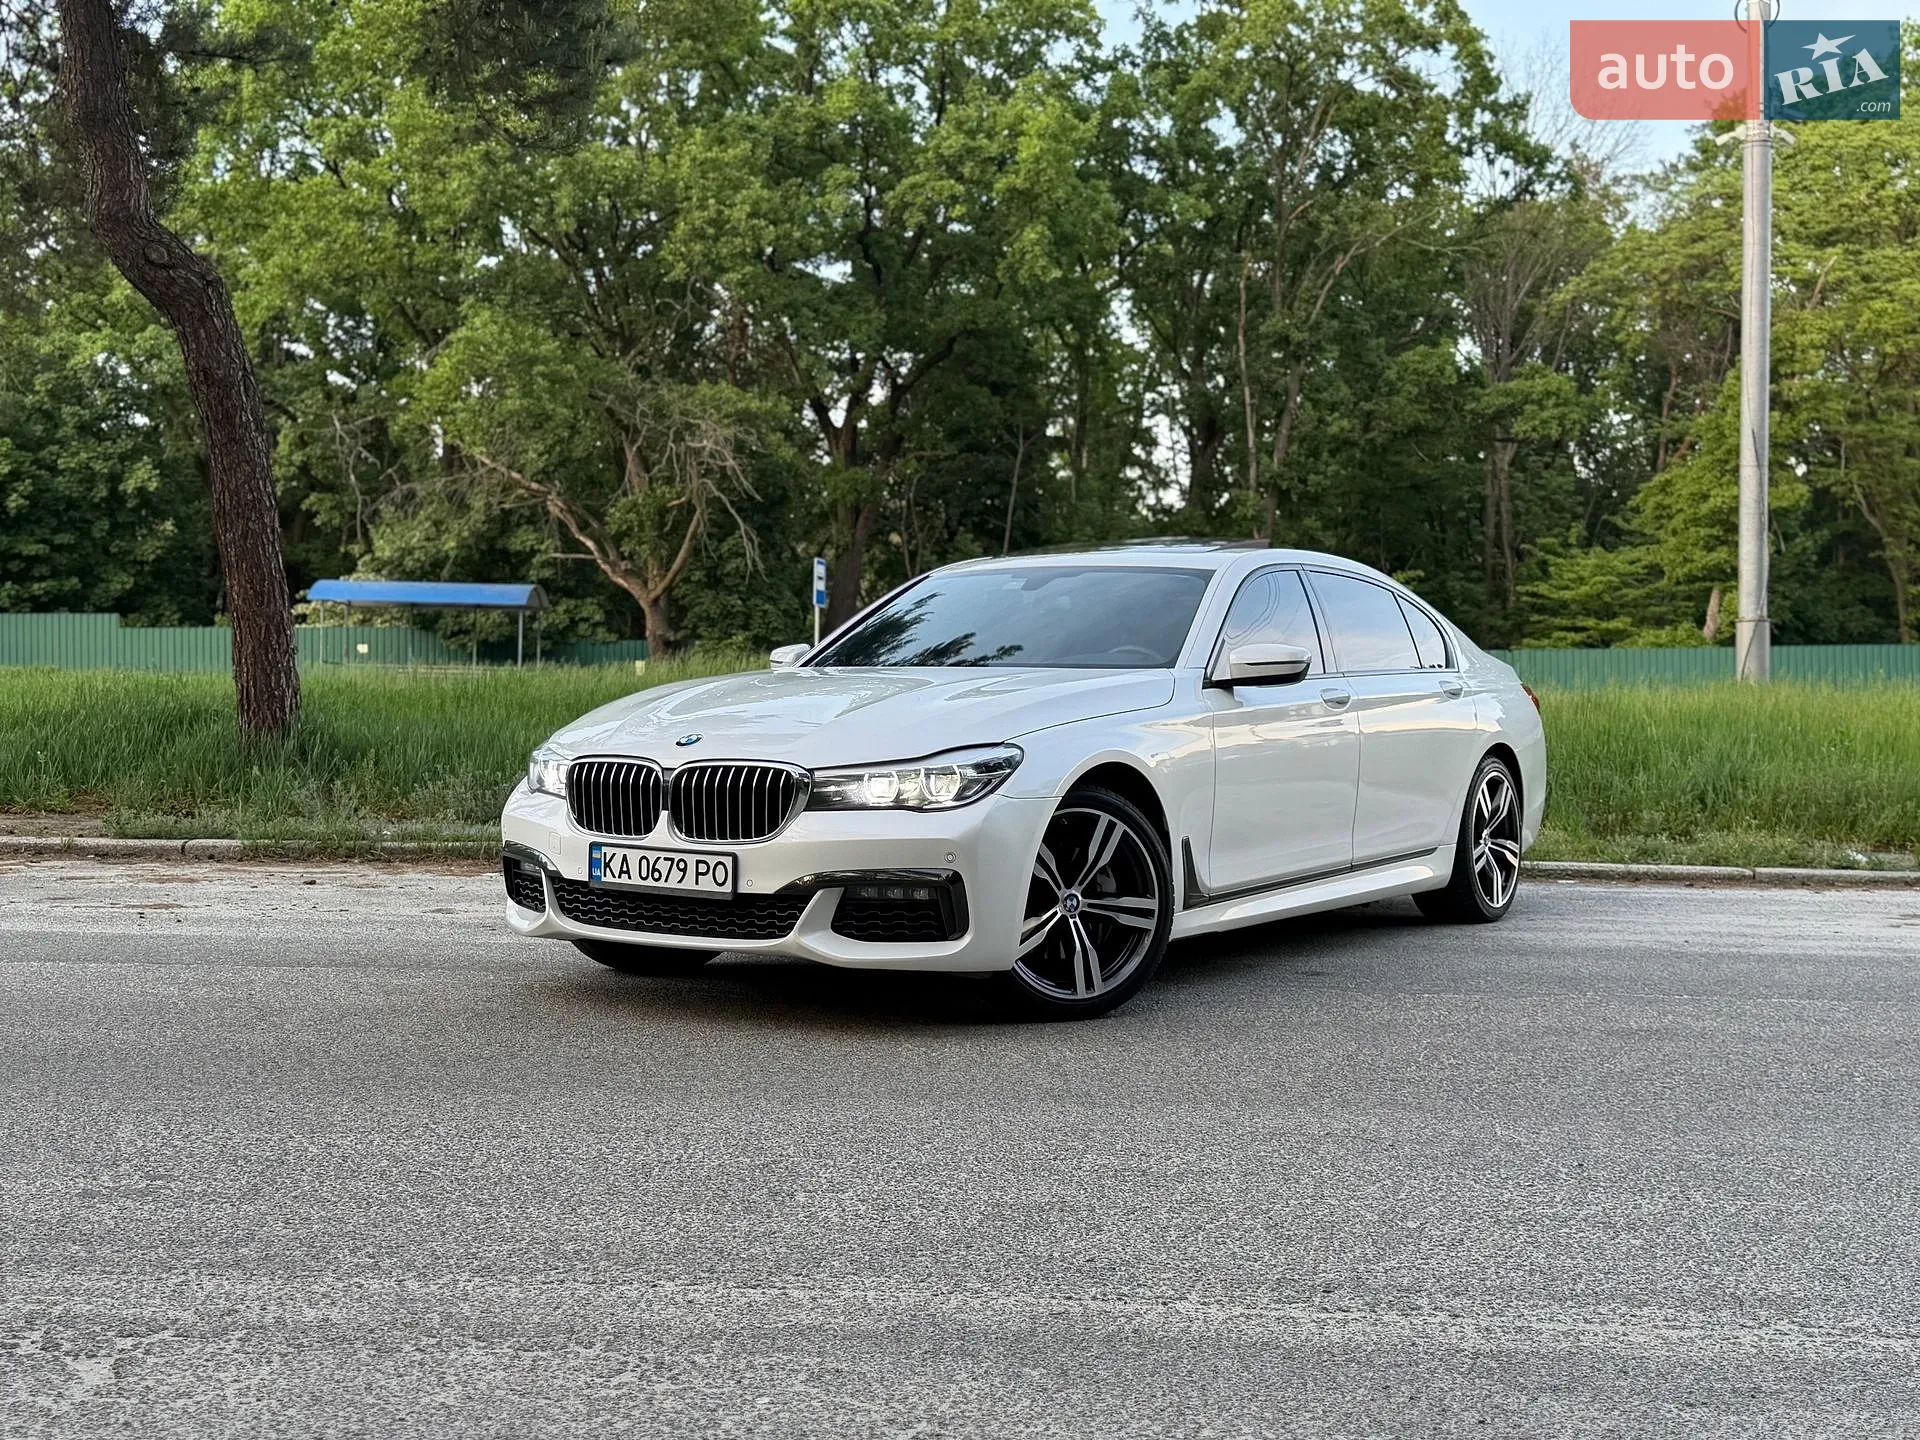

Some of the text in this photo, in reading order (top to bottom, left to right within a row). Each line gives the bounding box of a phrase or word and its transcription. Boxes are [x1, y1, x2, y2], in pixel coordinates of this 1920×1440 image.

[603, 851, 729, 887] KA 0679 PO
